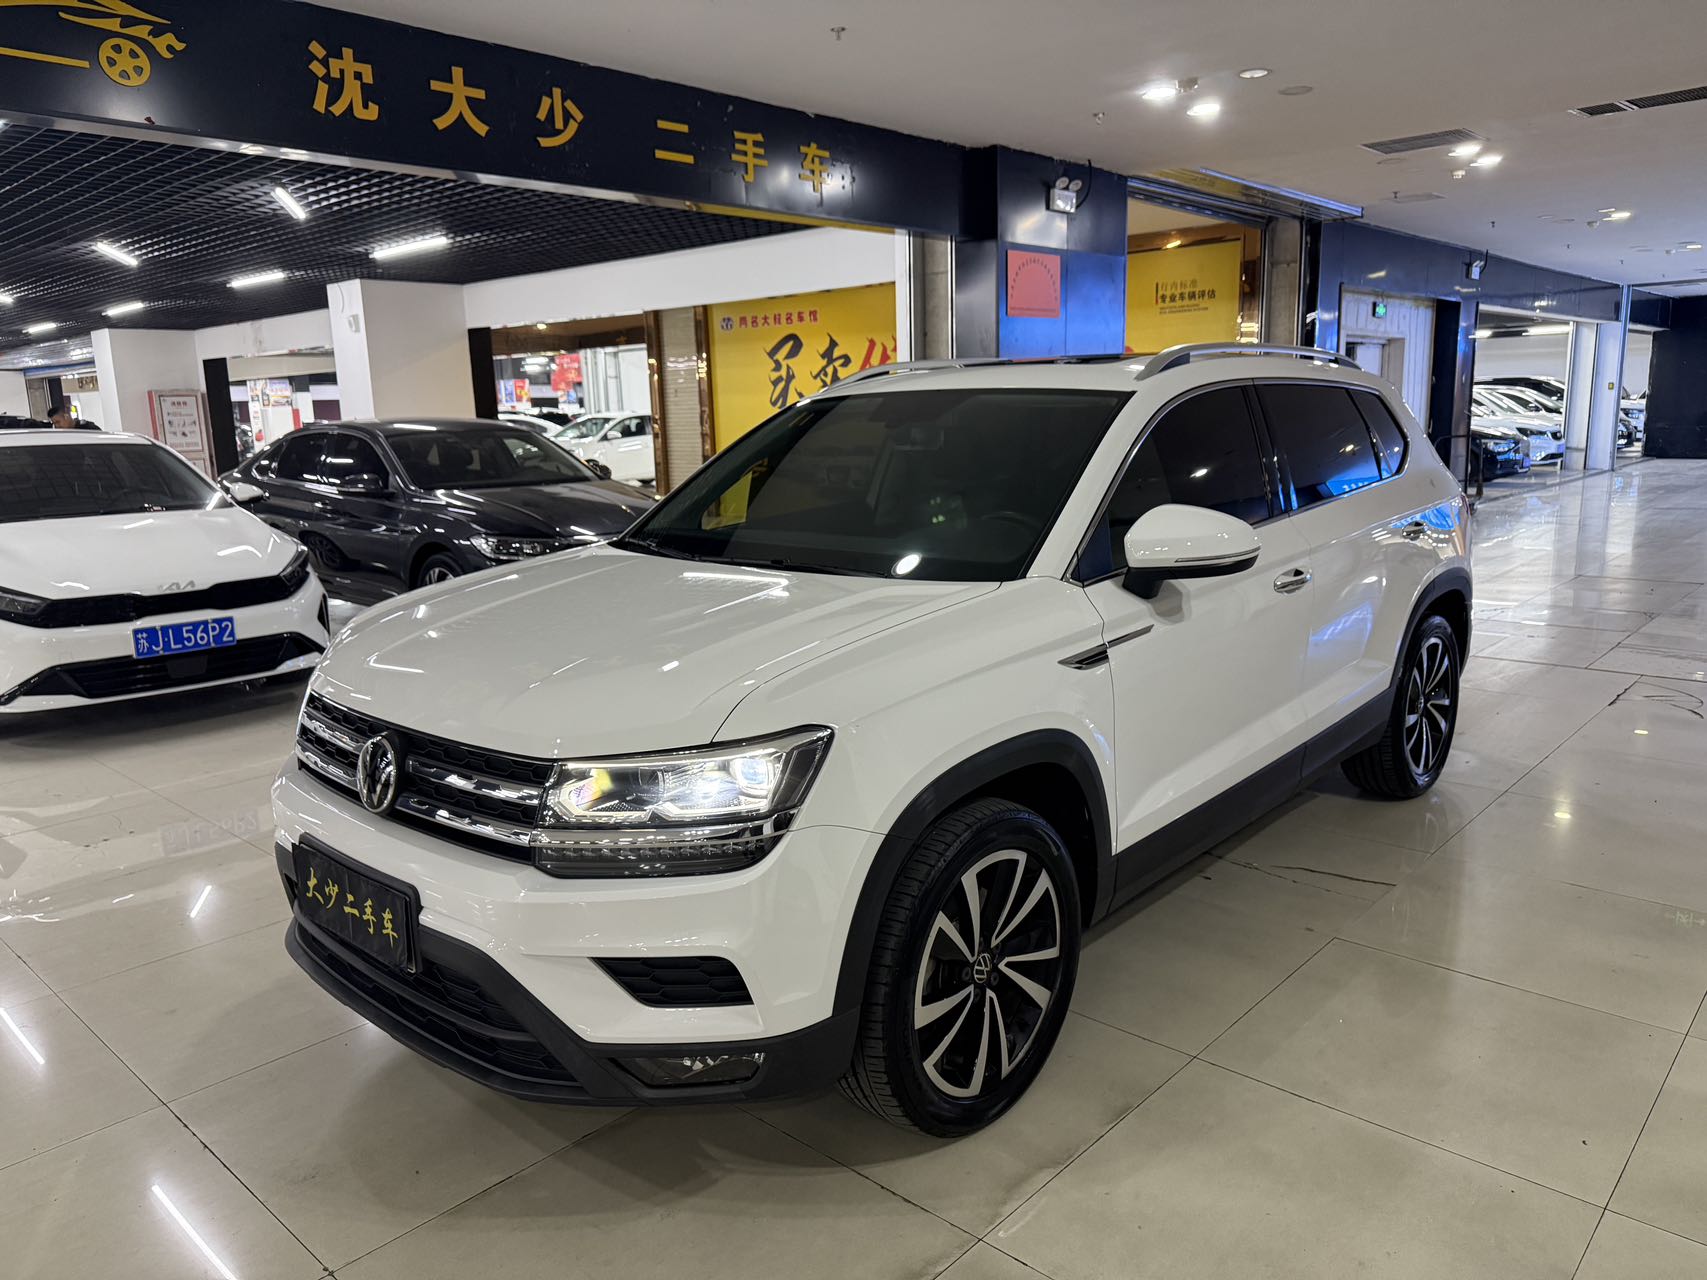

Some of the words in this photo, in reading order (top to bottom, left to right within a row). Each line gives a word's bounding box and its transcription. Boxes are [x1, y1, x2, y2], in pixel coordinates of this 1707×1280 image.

[307, 38, 831, 194] 沈大少二手车
[306, 867, 399, 948] 大少二手车
